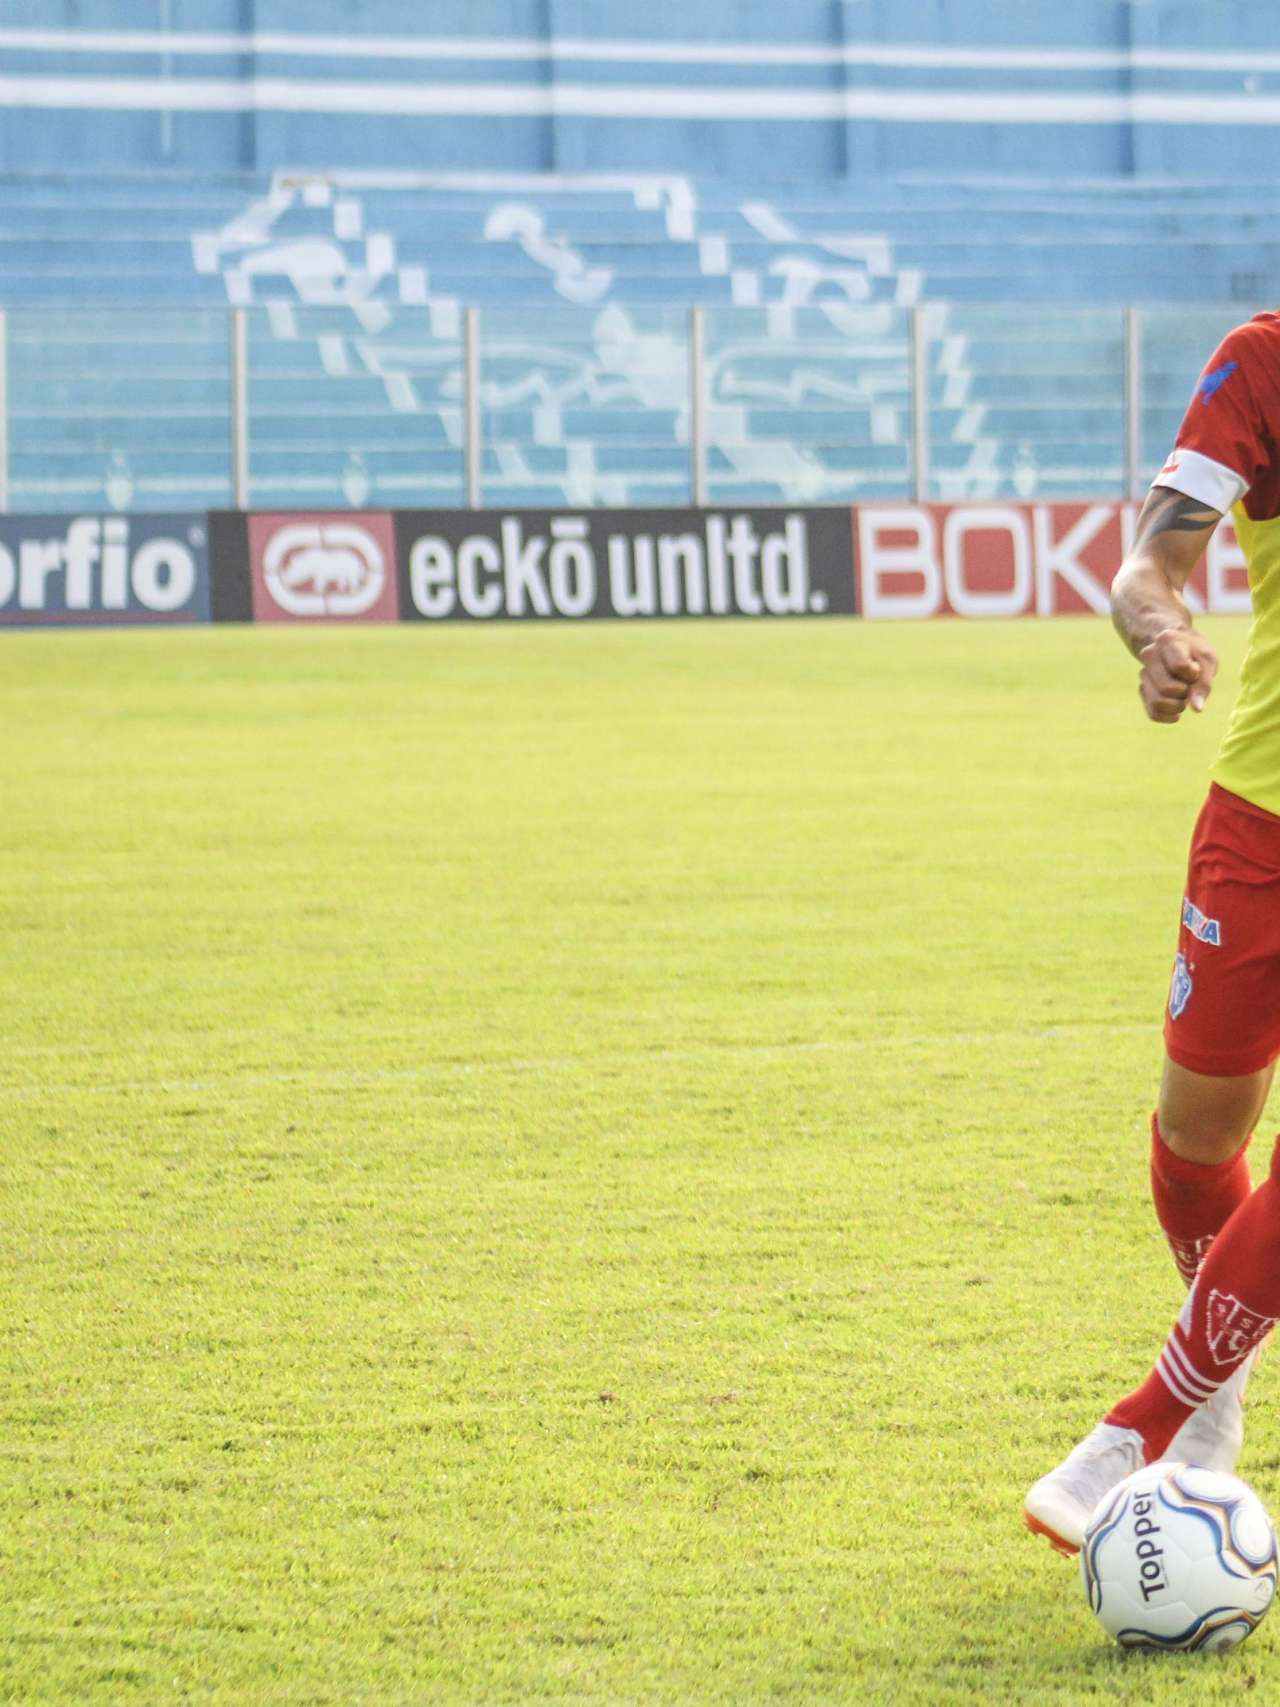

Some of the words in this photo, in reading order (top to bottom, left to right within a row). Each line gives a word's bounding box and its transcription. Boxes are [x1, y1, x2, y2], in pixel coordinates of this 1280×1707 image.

[0, 517, 196, 611] rfio
[607, 514, 828, 615] unltd.
[1132, 1491, 1165, 1602] Topper
